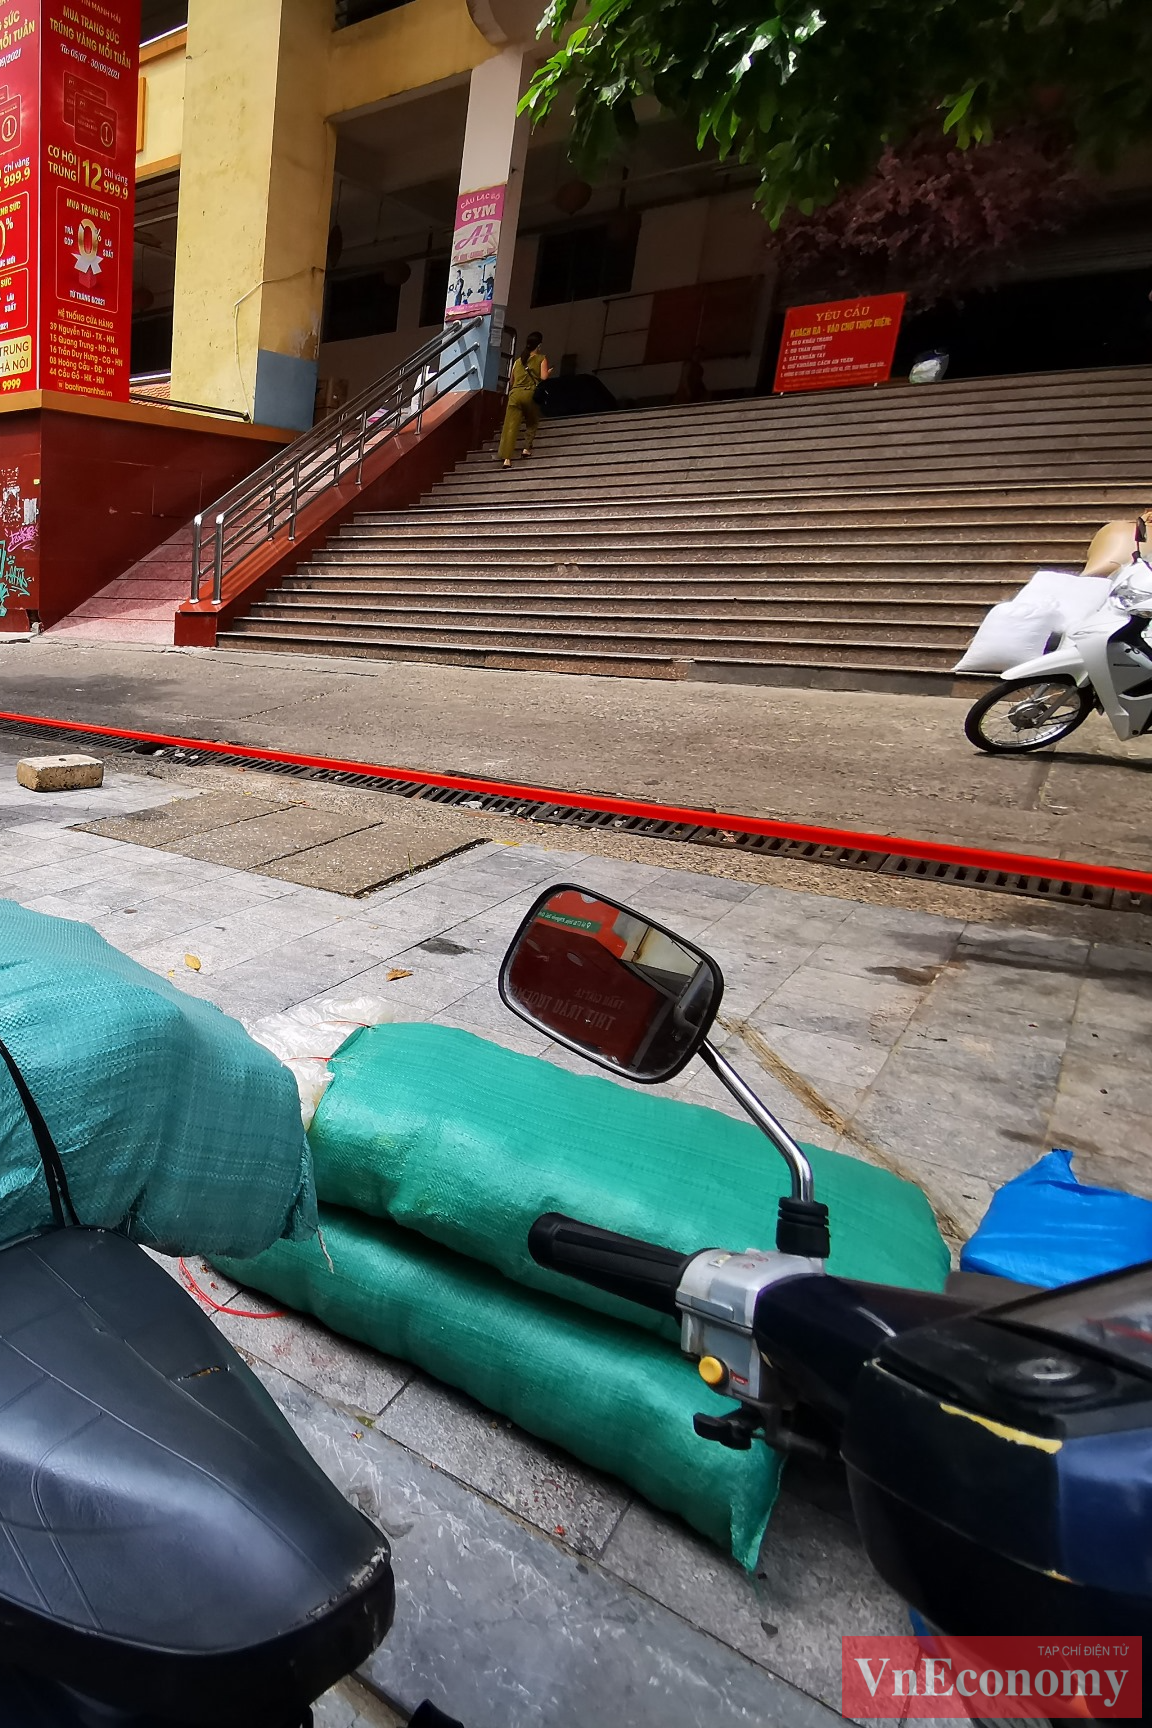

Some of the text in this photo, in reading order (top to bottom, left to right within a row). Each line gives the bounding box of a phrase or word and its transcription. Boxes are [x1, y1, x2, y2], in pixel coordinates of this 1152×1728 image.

[4, 10, 20, 28] SỨC
[63, 5, 120, 44] MUA TRANG SỨC
[13, 19, 34, 42] TUẦN
[50, 17, 131, 69] TRÚNG VÀNG MỖI TUẦN
[70, 49, 87, 63] 05/07
[90, 59, 120, 79] 30/09/2021
[48, 144, 76, 166] CƠ HỘI
[4, 157, 30, 174] Chỉ vàng
[48, 160, 76, 182] TRÚNG
[4, 167, 30, 188] 999.9
[82, 160, 102, 192] 12
[104, 167, 128, 186] Chỉ vàng
[104, 180, 128, 200] 999.9
[9, 201, 21, 213] SỨC
[66, 198, 111, 221] MUA TRANG SỨC
[462, 203, 496, 222] GYM
[1, 277, 12, 287] SỨC
[58, 308, 114, 329] HỆ THỐNG CỬA HÀNG
[816, 304, 870, 321] YÊU CẦU
[50, 322, 57, 330] 39
[59, 324, 80, 336] Nguyễn
[96, 333, 102, 341] TX
[106, 335, 114, 344] HN
[790, 326, 811, 338] KHÁCH
[50, 333, 57, 342] 15
[58, 336, 77, 348] Quang
[79, 340, 94, 352] Trung
[110, 347, 119, 355] HN
[12, 356, 28, 371] NỘI
[50, 345, 57, 353] 16
[58, 345, 70, 356] Trần
[72, 349, 82, 359] Duy
[102, 356, 111, 364] CG
[115, 358, 123, 367] HN
[58, 358, 77, 370] Hoàng
[78, 360, 90, 370] Cầu
[3, 378, 21, 391] 9999
[58, 368, 70, 377] Cầu
[71, 370, 80, 380] Gỗ
[96, 376, 104, 384] HN
[65, 382, 112, 397] baotinmanhhai.vn
